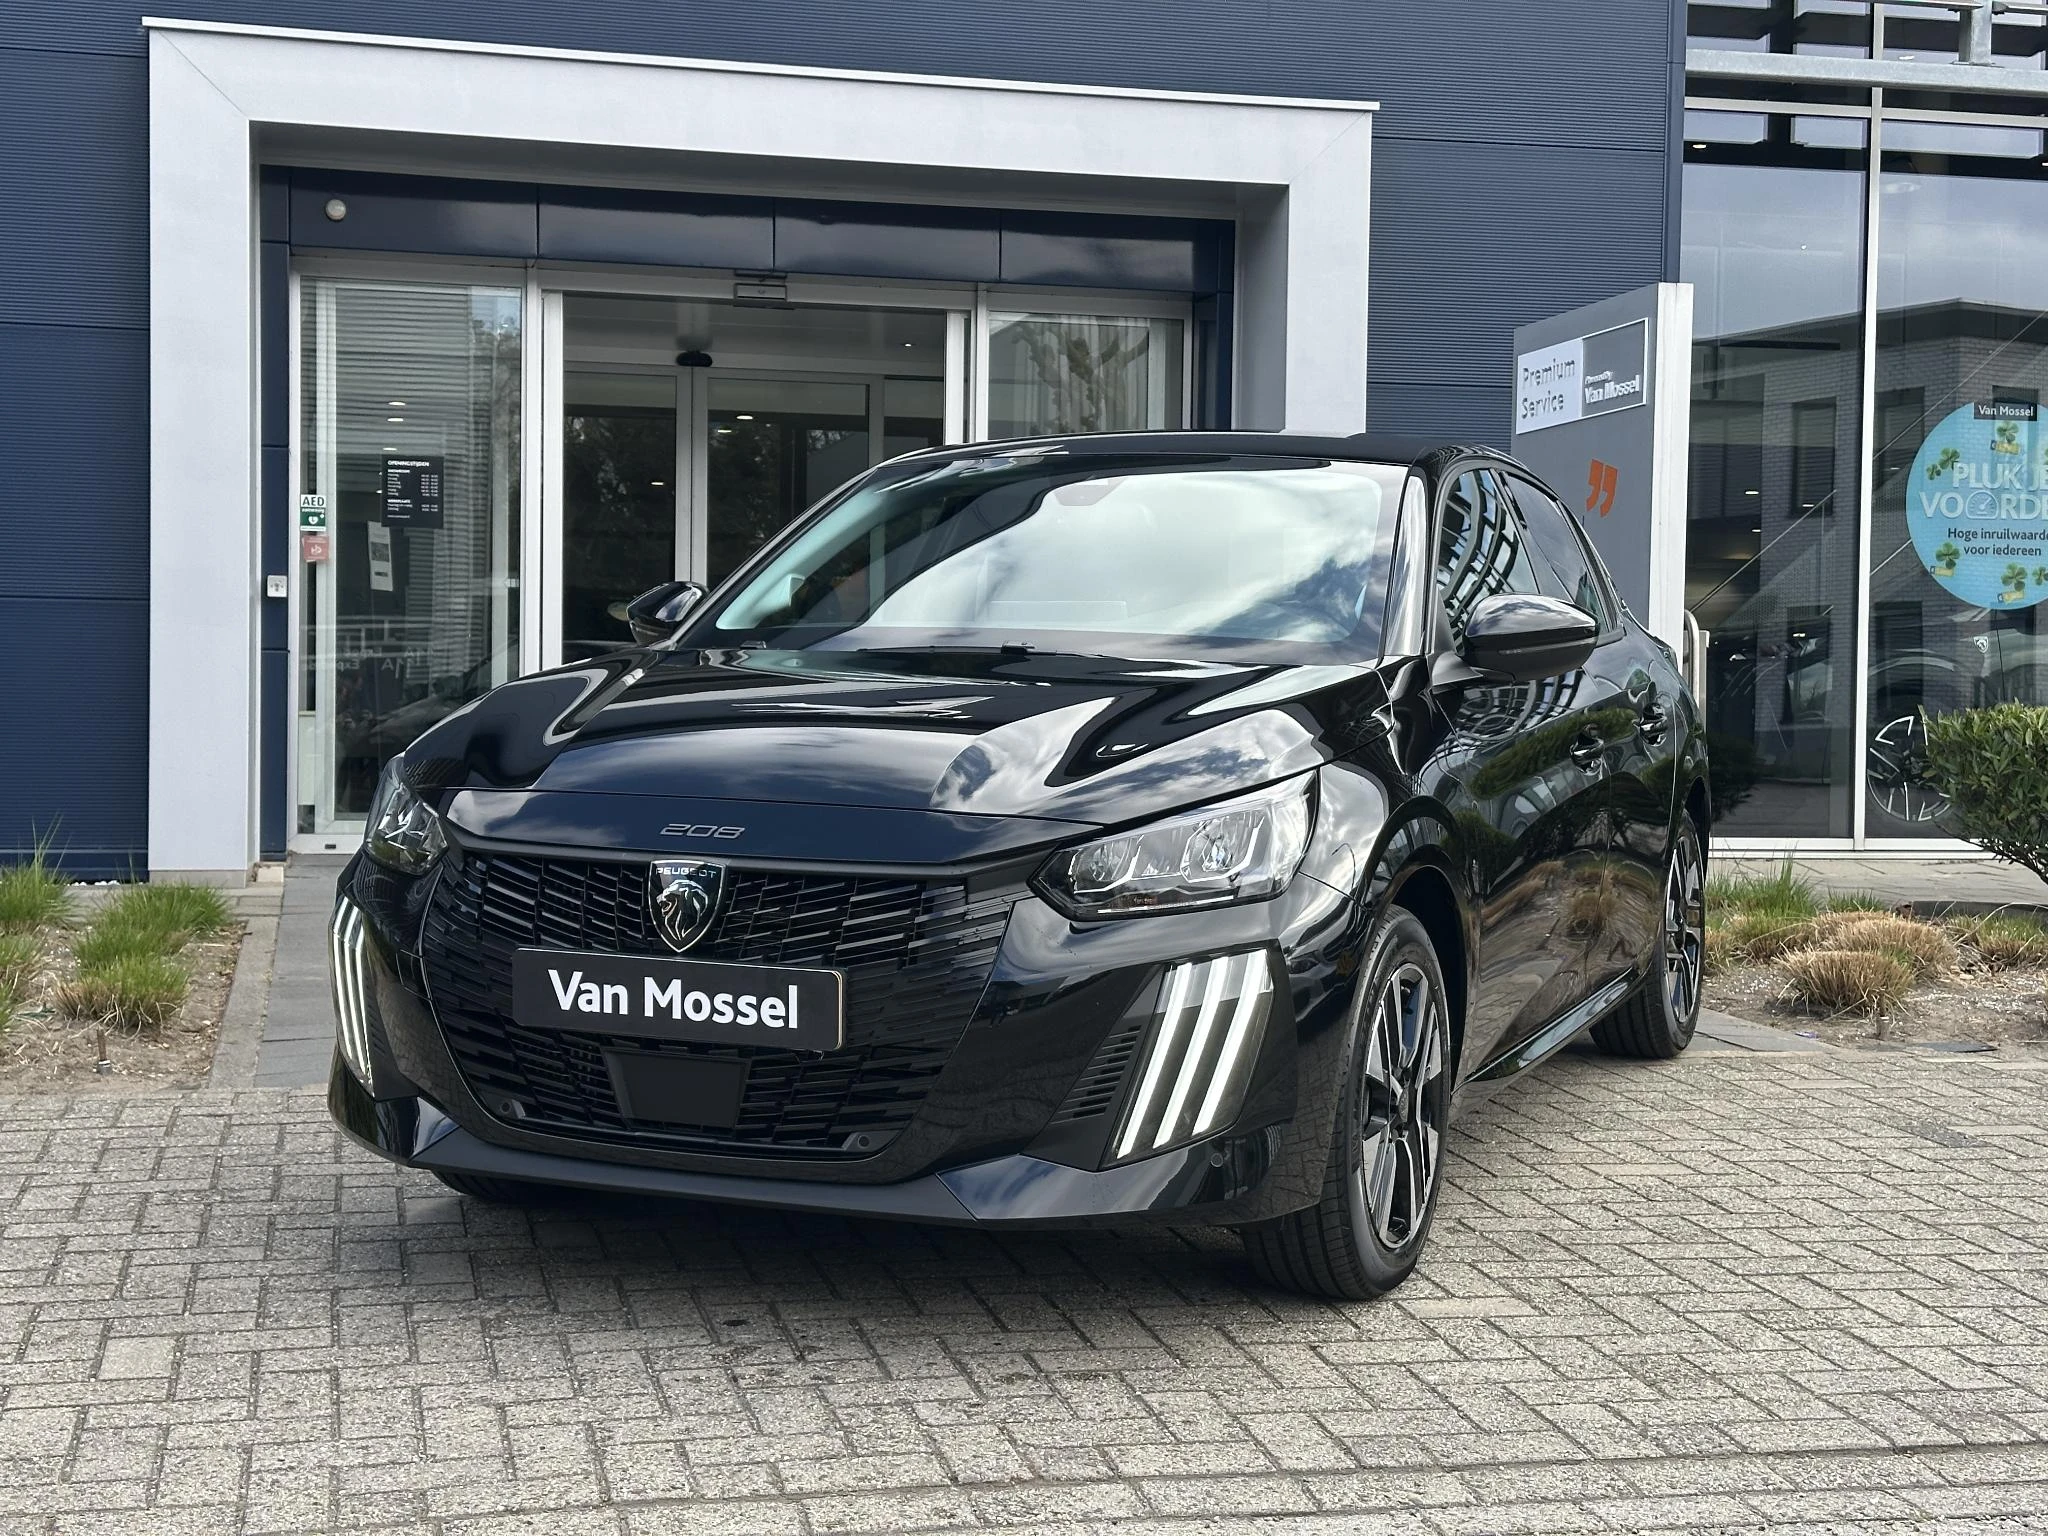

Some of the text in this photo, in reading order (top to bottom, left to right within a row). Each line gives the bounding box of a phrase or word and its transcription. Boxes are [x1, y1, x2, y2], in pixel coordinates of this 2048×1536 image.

[1522, 358, 1575, 388] Premium
[1585, 375, 1640, 404] Van Mossel
[1521, 390, 1564, 419] Service
[1978, 405, 2034, 417] Van Mossel
[1952, 463, 2023, 490] PLUK
[302, 496, 325, 507] AED
[1947, 528, 2048, 542] Hoge inruilwaard
[1963, 544, 2042, 556] voor iedereen
[659, 823, 746, 839] 208
[656, 866, 717, 879] PEUGEOT
[548, 968, 798, 1029] Van Mossel
